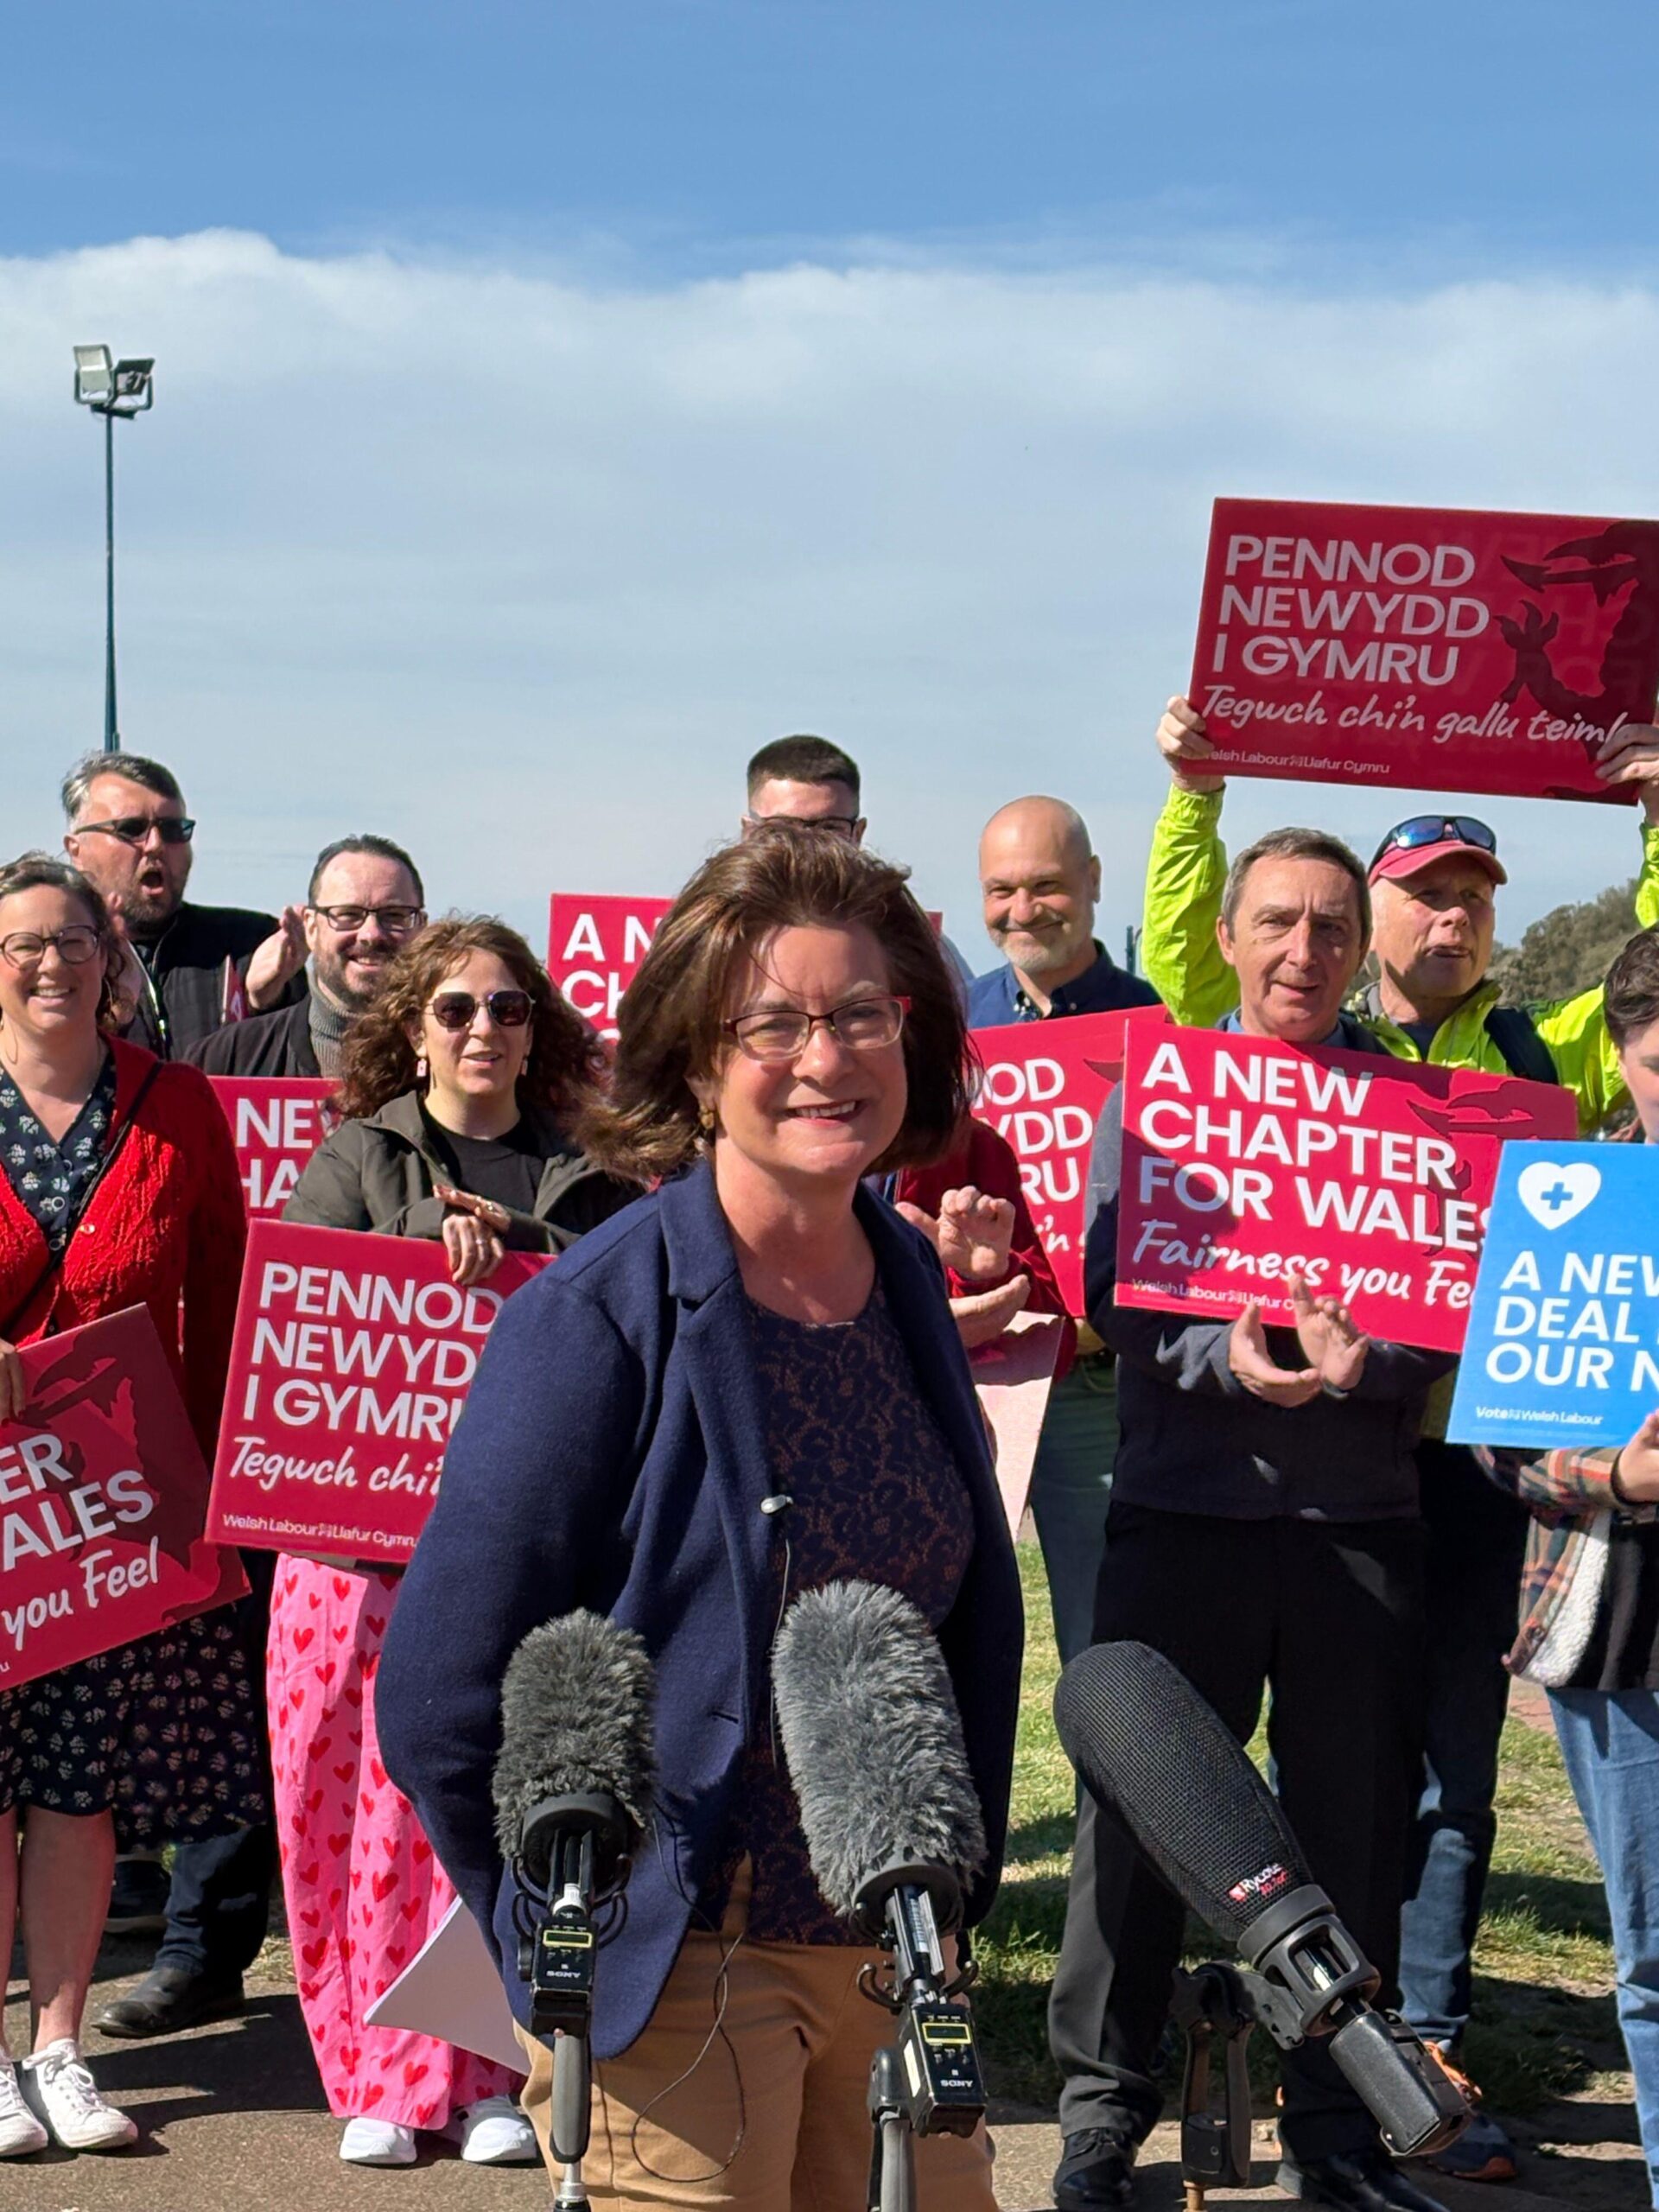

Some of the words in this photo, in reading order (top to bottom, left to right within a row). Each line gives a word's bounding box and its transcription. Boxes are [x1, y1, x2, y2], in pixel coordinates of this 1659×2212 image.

[1224, 534, 1476, 588] PENNOD
[1217, 584, 1491, 639] NEWYDD
[1211, 632, 1228, 673] I
[1241, 635, 1460, 686] GYMRU
[1202, 684, 1328, 731] Tegwch
[1433, 702, 1520, 745] gallu
[1527, 710, 1629, 744] teiml
[1205, 749, 1239, 761] elsh
[1241, 750, 1288, 767] Labour
[1343, 760, 1390, 774] Cymru
[562, 913, 606, 962] A
[1141, 1042, 1192, 1094] A
[1213, 1050, 1374, 1117] NEW
[1140, 1100, 1459, 1191] CHAPTER
[1139, 1156, 1274, 1221] FOR
[1295, 1176, 1491, 1253] WALE
[1132, 1218, 1330, 1287] Fairness
[1338, 1262, 1412, 1302] you
[1426, 1259, 1475, 1311] Fe
[1499, 1250, 1541, 1292] A
[259, 1262, 505, 1335] PENNOD
[1179, 1283, 1230, 1301] Labour
[1493, 1295, 1640, 1344] DEAL
[251, 1318, 486, 1388] NEWYD
[1485, 1342, 1614, 1390] OUR
[243, 1374, 260, 1421] I
[1476, 1406, 1508, 1420] Vote
[1560, 1411, 1604, 1426] Labour
[228, 1435, 359, 1491] Tegwch
[222, 1514, 268, 1530] Welsh
[269, 1516, 320, 1536] Labour
[1, 1585, 74, 1651] you
[79, 1535, 160, 1610] Feel
[546, 1970, 582, 1979] SONY
[940, 2079, 974, 2088] SONY
